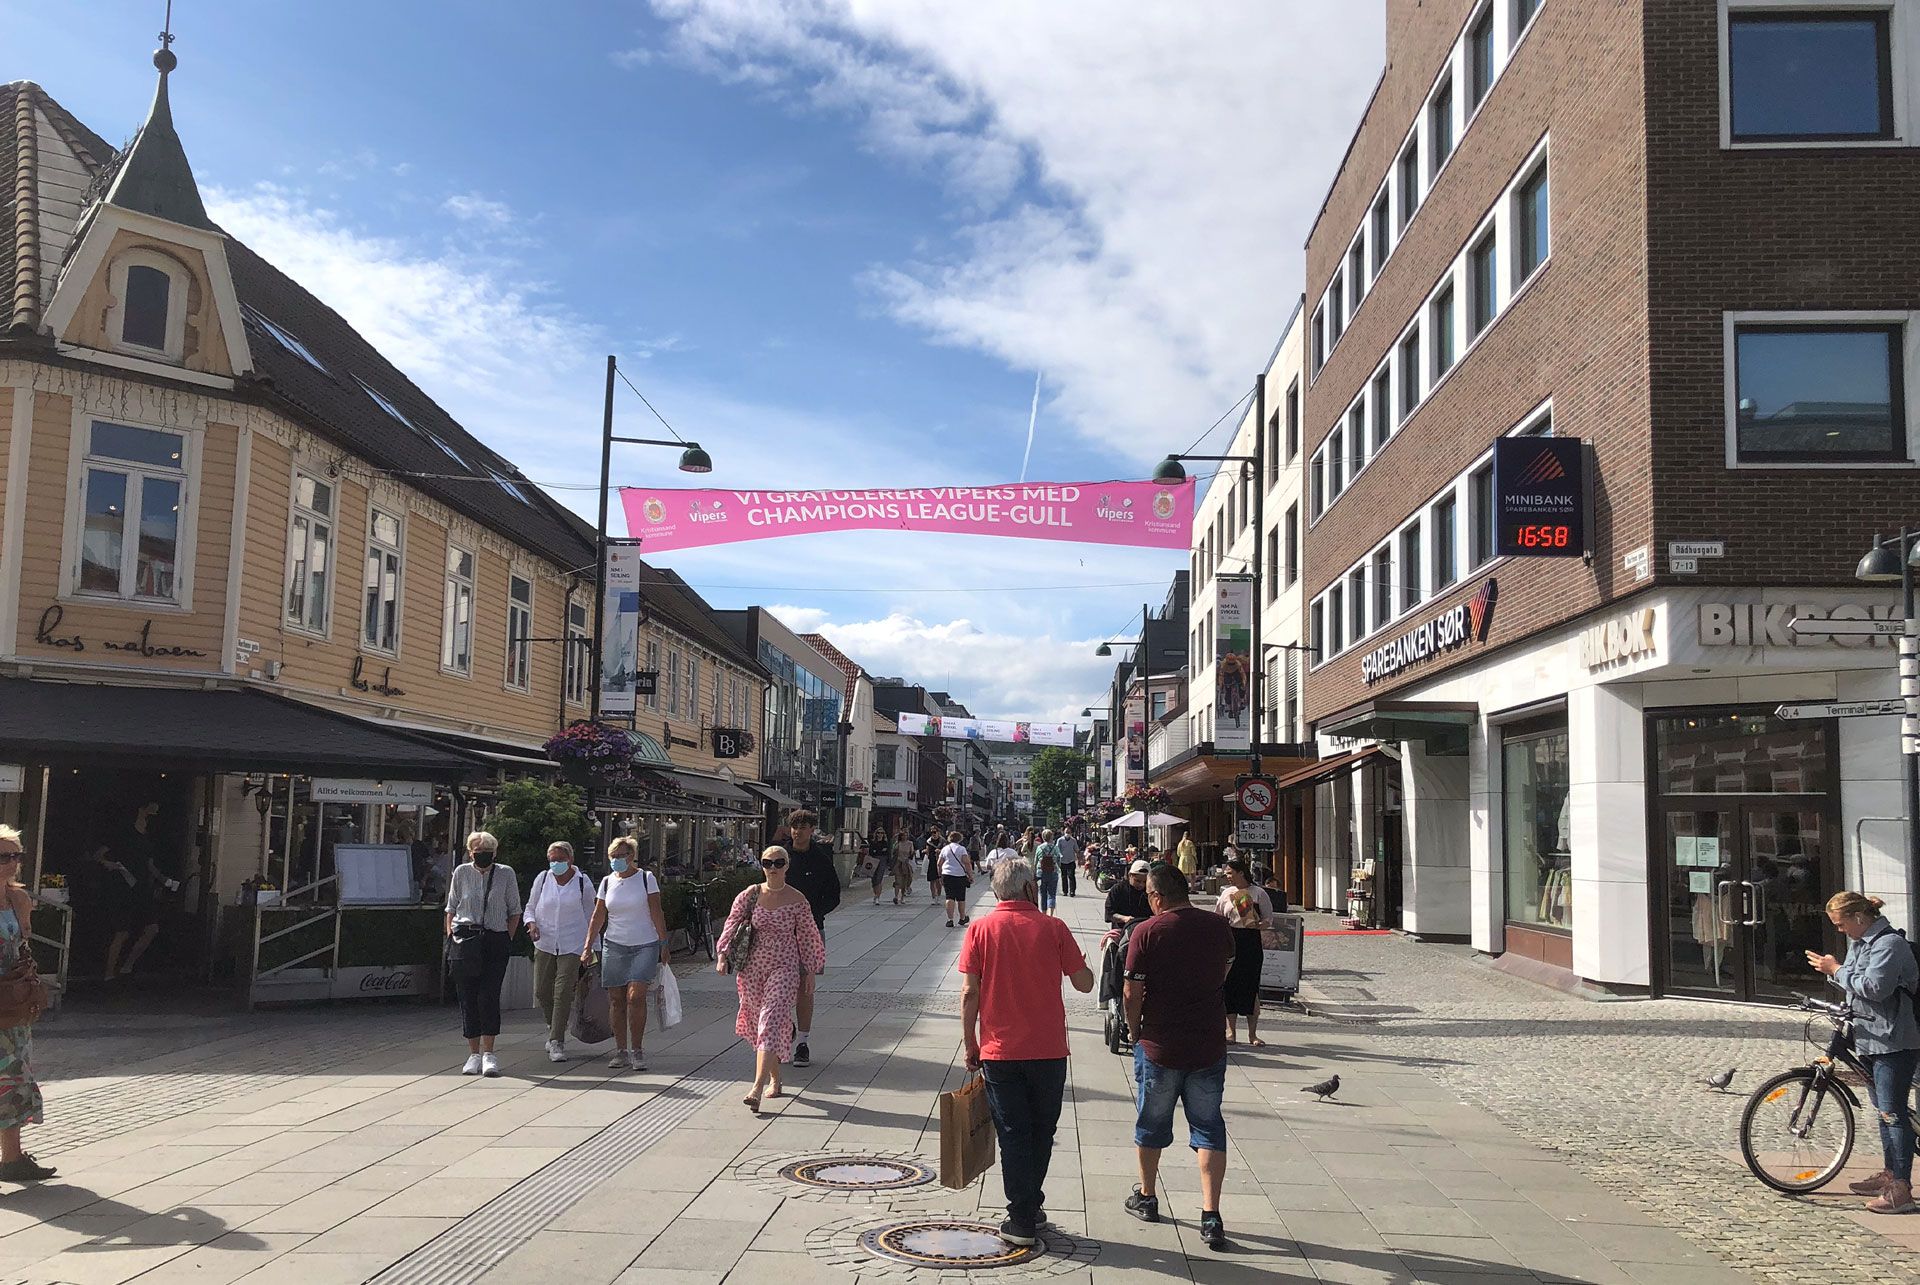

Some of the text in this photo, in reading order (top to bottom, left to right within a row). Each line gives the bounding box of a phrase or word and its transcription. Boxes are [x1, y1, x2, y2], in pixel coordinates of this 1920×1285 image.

[733, 491, 760, 504] VI
[1023, 487, 1080, 502] MED
[1505, 495, 1573, 505] MINIBANK
[689, 511, 727, 524] Vipers
[747, 503, 1073, 527] CHAMPIONS LEAGUE-GULL
[1096, 507, 1134, 521] Vipers
[1518, 526, 1569, 547] 16:58
[1675, 544, 1718, 555] Rådhusgata
[1675, 561, 1694, 570] 7-13
[36, 605, 84, 651] hos
[1873, 622, 1893, 632] Taxi
[1361, 604, 1465, 684] SPAREBANKEN SØR
[1579, 608, 1656, 669] BIKBOK
[1824, 704, 1866, 715] Terminal
[317, 787, 338, 795] Alltid
[340, 788, 383, 797] velkommen
